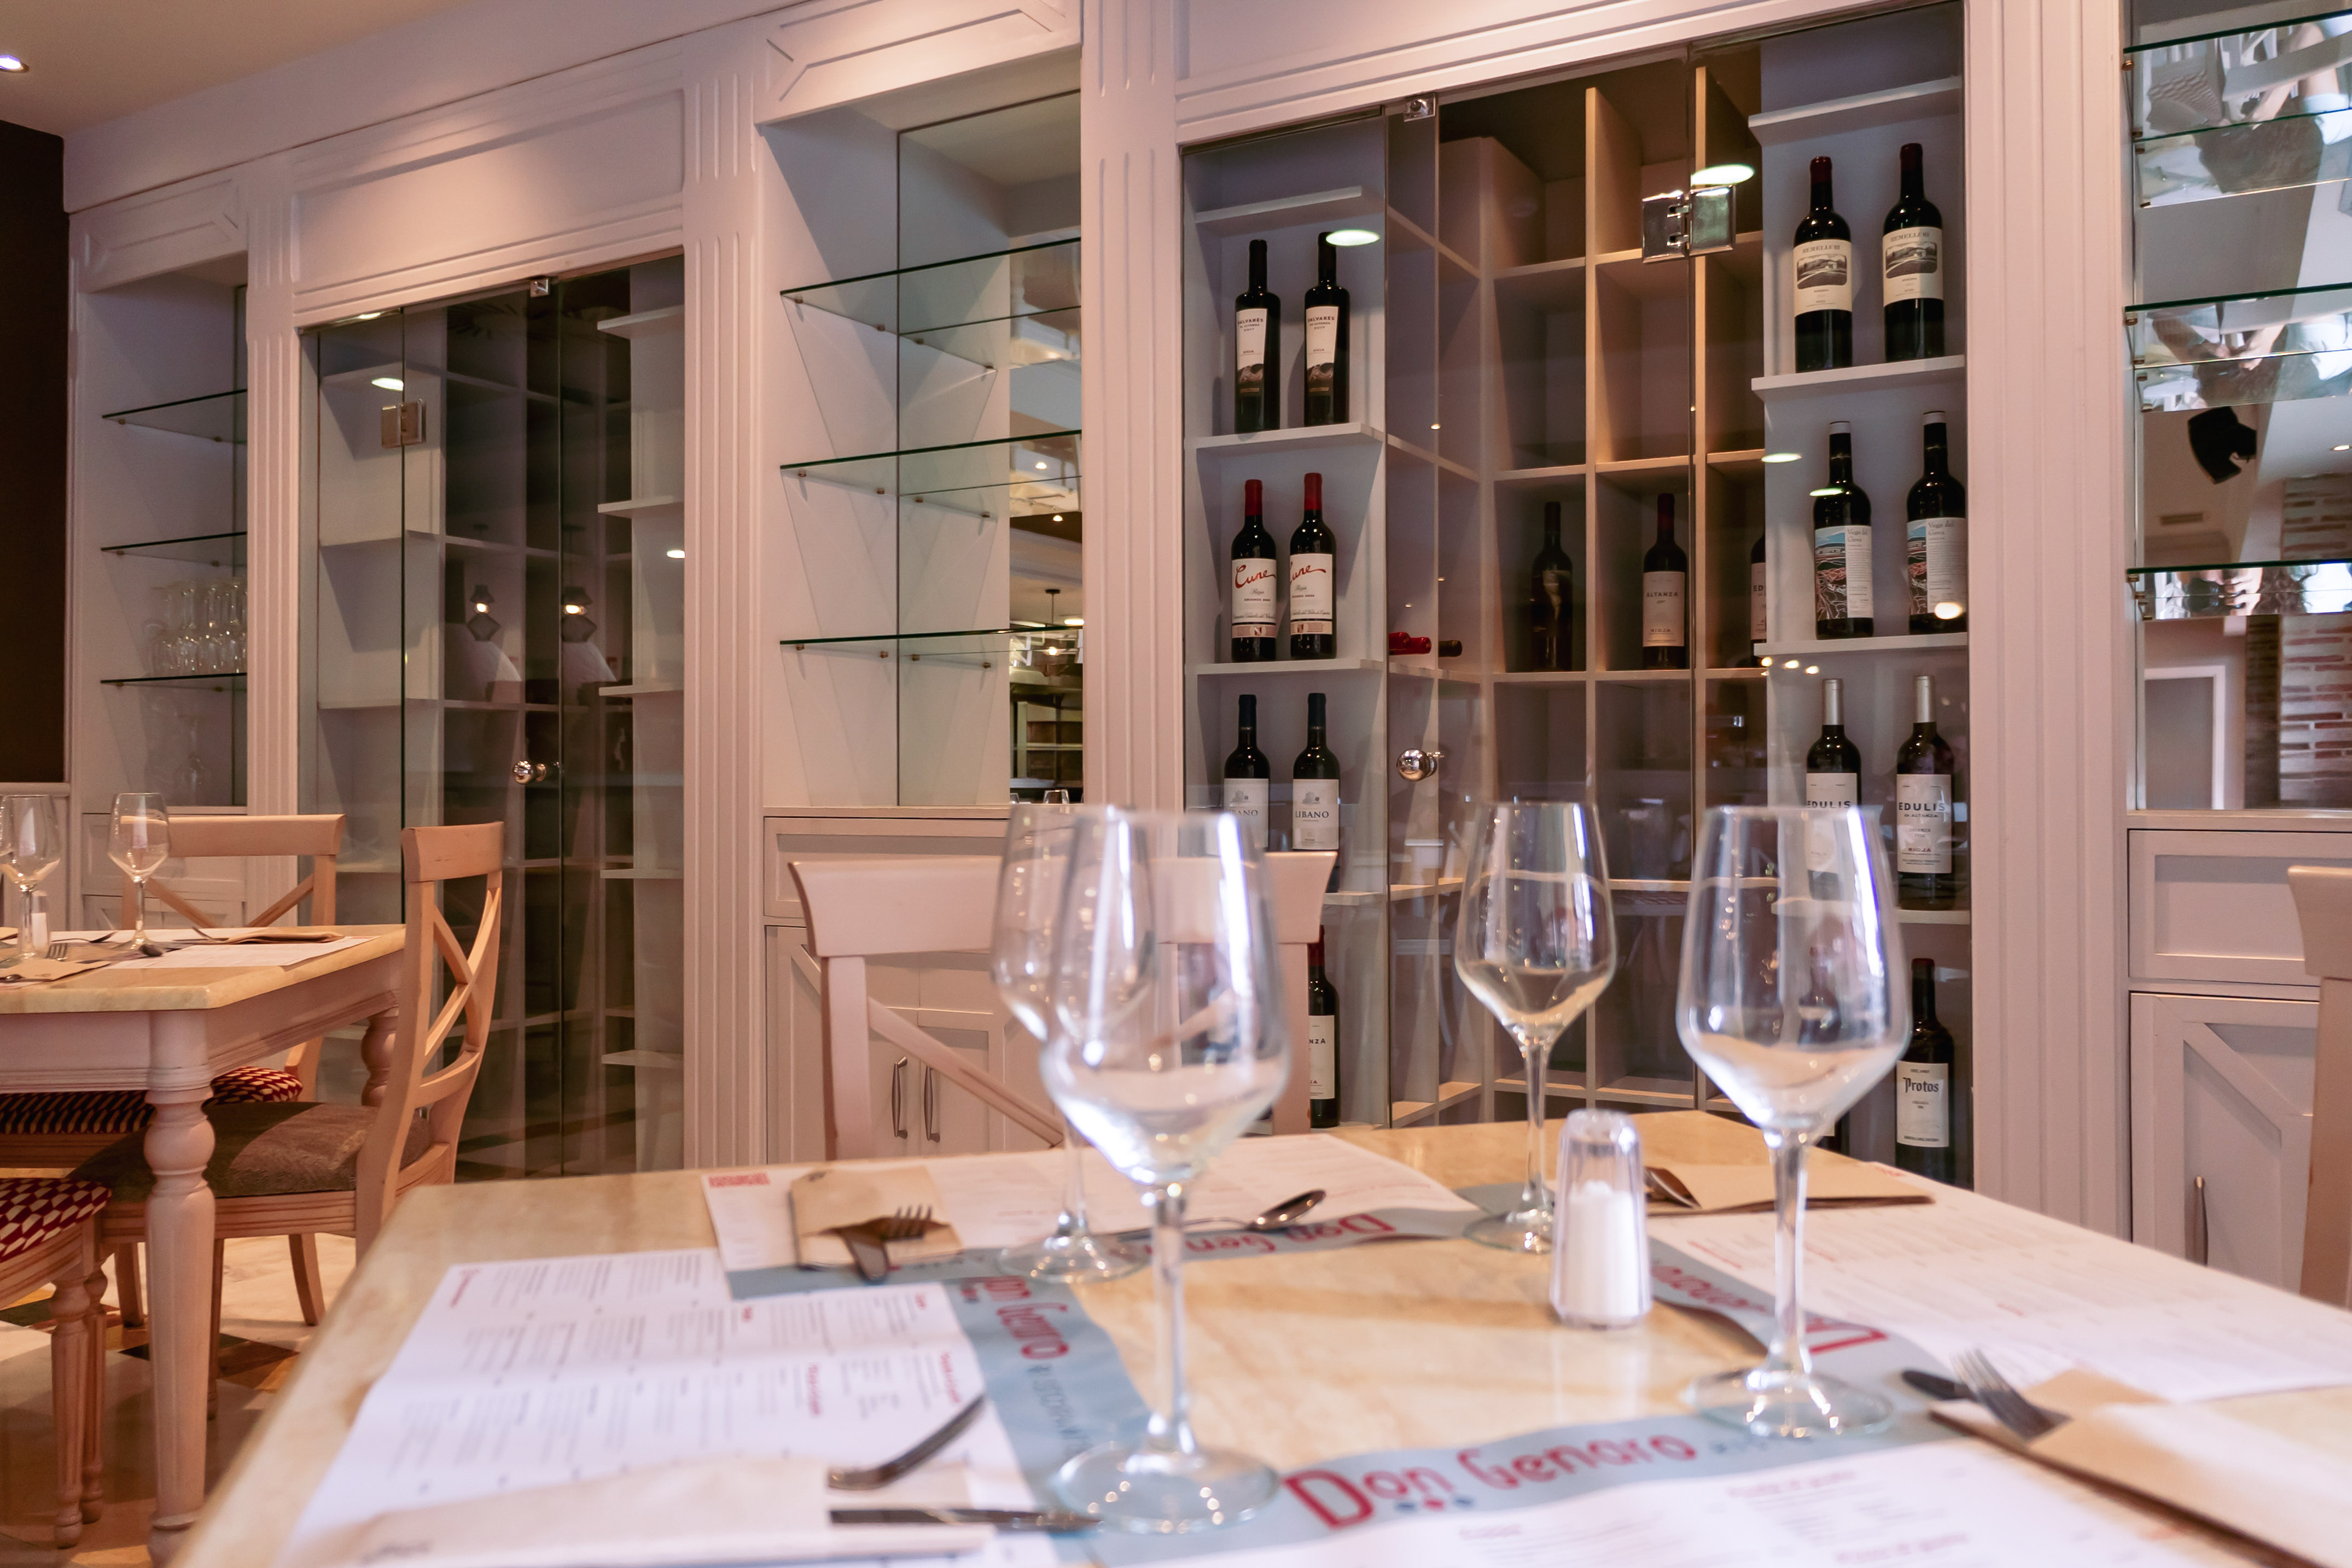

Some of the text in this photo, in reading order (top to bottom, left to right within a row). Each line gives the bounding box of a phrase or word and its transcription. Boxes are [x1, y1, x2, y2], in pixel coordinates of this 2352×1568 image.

[1235, 564, 1276, 589] Cune
[1295, 810, 1330, 819] LIBANO
[1899, 802, 1946, 812] EDULIS
[1902, 1077, 1939, 1093] Protos
[1280, 1468, 1456, 1532] Don
[1456, 1434, 1698, 1490] Genaro
